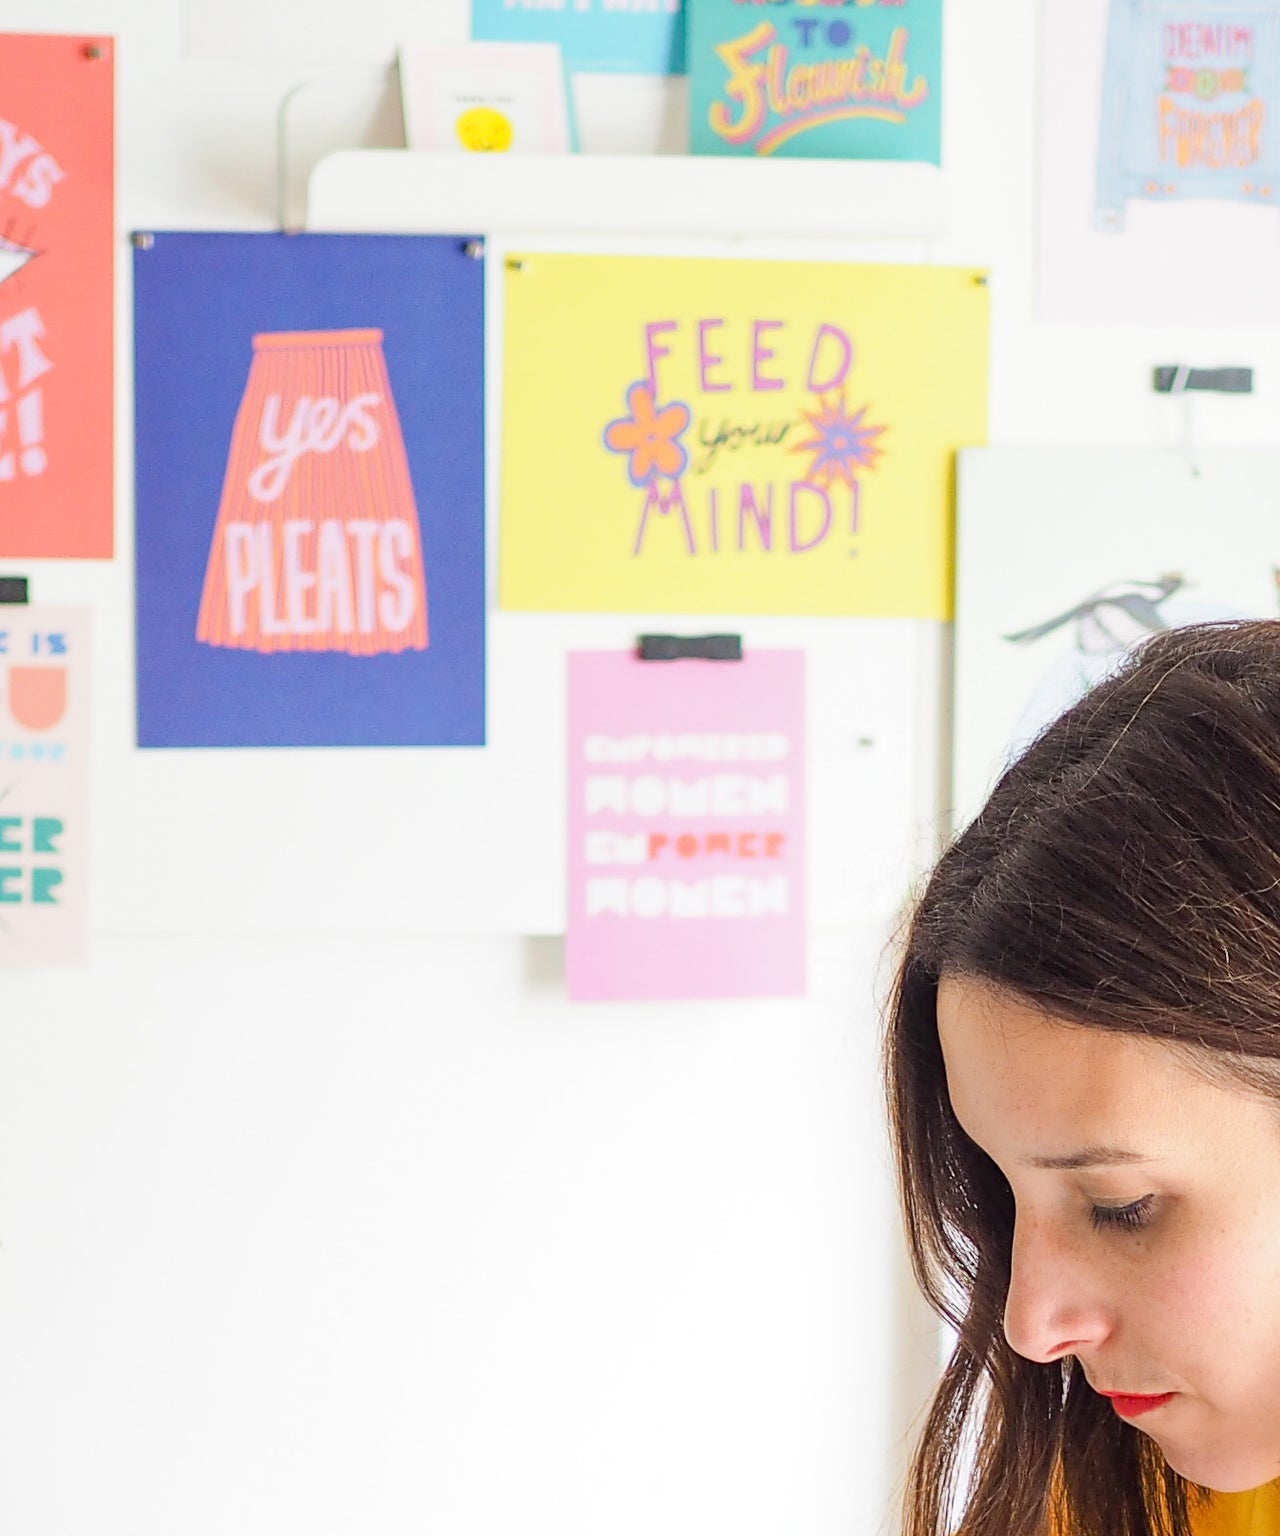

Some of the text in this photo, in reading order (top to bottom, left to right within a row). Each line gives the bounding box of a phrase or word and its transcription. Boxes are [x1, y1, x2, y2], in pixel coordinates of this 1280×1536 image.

[793, 18, 853, 48] TO
[645, 318, 854, 398] FEED
[248, 392, 386, 503] yes
[633, 477, 860, 560] MIND!
[224, 518, 417, 637] PLEATS
[30, 631, 68, 656] IS
